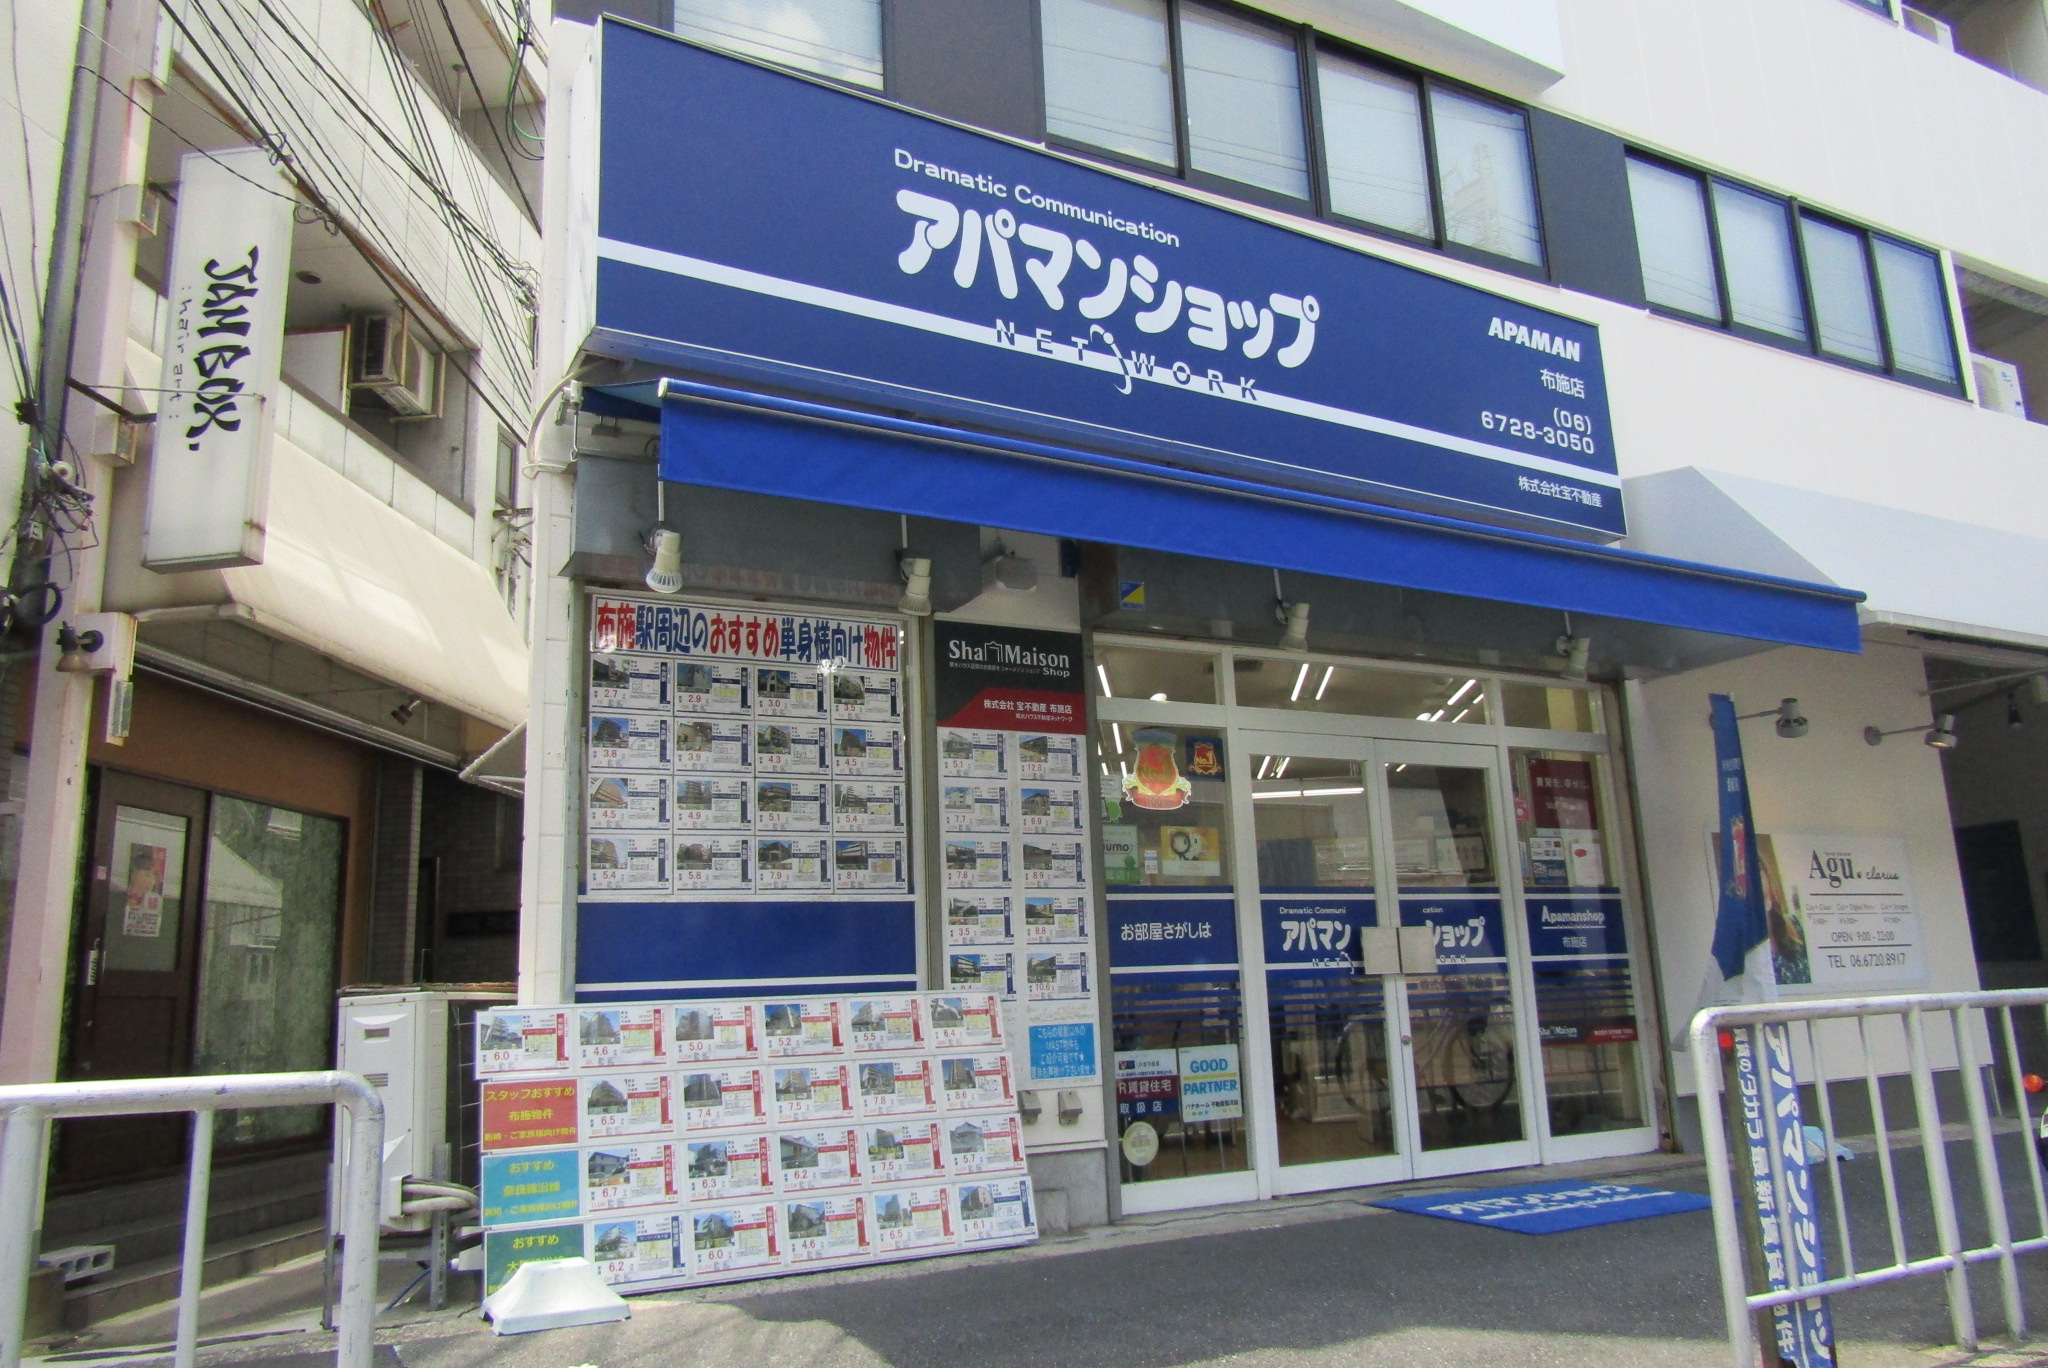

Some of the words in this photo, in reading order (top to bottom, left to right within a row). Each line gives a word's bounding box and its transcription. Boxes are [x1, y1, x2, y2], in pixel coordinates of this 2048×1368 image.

[895, 148, 1007, 198] Dramatic
[1014, 185, 1180, 248] Communication
[896, 189, 1320, 368] アパマンショップ
[197, 245, 259, 339] JAM
[1488, 317, 1580, 362] APAMAN
[1540, 368, 1585, 399] 布施店
[1553, 407, 1592, 435] (06)
[1481, 411, 1594, 454] 6728-3050
[1518, 476, 1602, 508] 株式会社宝不動産
[597, 601, 896, 669] 布施駅周辺のおすすめ単身様向け物件
[1005, 644, 1070, 668] Maison
[1042, 666, 1070, 678] Shop
[604, 689, 618, 698] 2.7
[688, 694, 702, 703] 2.9
[768, 699, 781, 708] 3.0
[983, 699, 1014, 710] 株式会社
[1016, 701, 1047, 713] 宝不動産
[1050, 704, 1072, 714] 布施店
[603, 749, 617, 758] 3.8
[688, 753, 702, 761] 3.9
[768, 755, 781, 764] 4.3
[953, 761, 964, 769] 5.1
[1028, 764, 1042, 772] 12.8
[602, 810, 617, 819] 4.5
[688, 812, 702, 820] 4.9
[768, 813, 781, 822] 5.1
[845, 814, 858, 823] 5.4
[602, 871, 617, 879] 5.4
[688, 871, 702, 880] 5.8
[770, 871, 782, 879] 7.9
[846, 872, 858, 880] 8.1
[957, 871, 968, 879] 7.8
[1033, 871, 1044, 879] 8.9
[1279, 906, 1313, 915] Dramatic
[1314, 906, 1346, 915] Communi
[1422, 906, 1443, 914] cation
[959, 927, 970, 936] 3.5
[1035, 926, 1046, 935] 8.8
[1120, 921, 1212, 941] お部屋さがしは
[1281, 917, 1351, 951] アパマン
[1831, 932, 1853, 942] OPEN
[1877, 931, 1895, 941] 22:00
[1827, 955, 1846, 968] TEL
[1850, 953, 1906, 967] 06.6720.8917
[1036, 983, 1050, 991] 10.6
[863, 1032, 876, 1042] 5.5
[943, 1029, 956, 1038] 6.4
[689, 1041, 703, 1051] 5.0
[778, 1037, 792, 1047] 5.2
[494, 1051, 510, 1061] 6.0
[593, 1047, 609, 1056] 4.6
[1190, 1058, 1229, 1073] GOOD
[1183, 1079, 1237, 1096] PARTNER
[486, 1086, 575, 1101] スタッフおすすめ
[955, 1090, 967, 1099] 8.6
[788, 1101, 802, 1111] 7.5
[873, 1096, 886, 1106] 7.8
[508, 1108, 554, 1121] 布施物件
[697, 1108, 712, 1118] 7.4
[601, 1115, 616, 1125] 6.5
[963, 1153, 975, 1163] 5.7
[508, 1160, 555, 1175] おすすめ
[881, 1161, 894, 1171] 7.5
[794, 1169, 808, 1179] 6.2
[702, 1178, 717, 1188] 6.3
[602, 1187, 618, 1198] 6.7
[973, 1220, 985, 1230] 6.1
[889, 1228, 903, 1239] 6.5
[512, 1234, 559, 1249] おすすめ
[801, 1239, 816, 1249] 4.6
[708, 1249, 724, 1260] 6.0
[608, 1261, 624, 1272] 6.2
